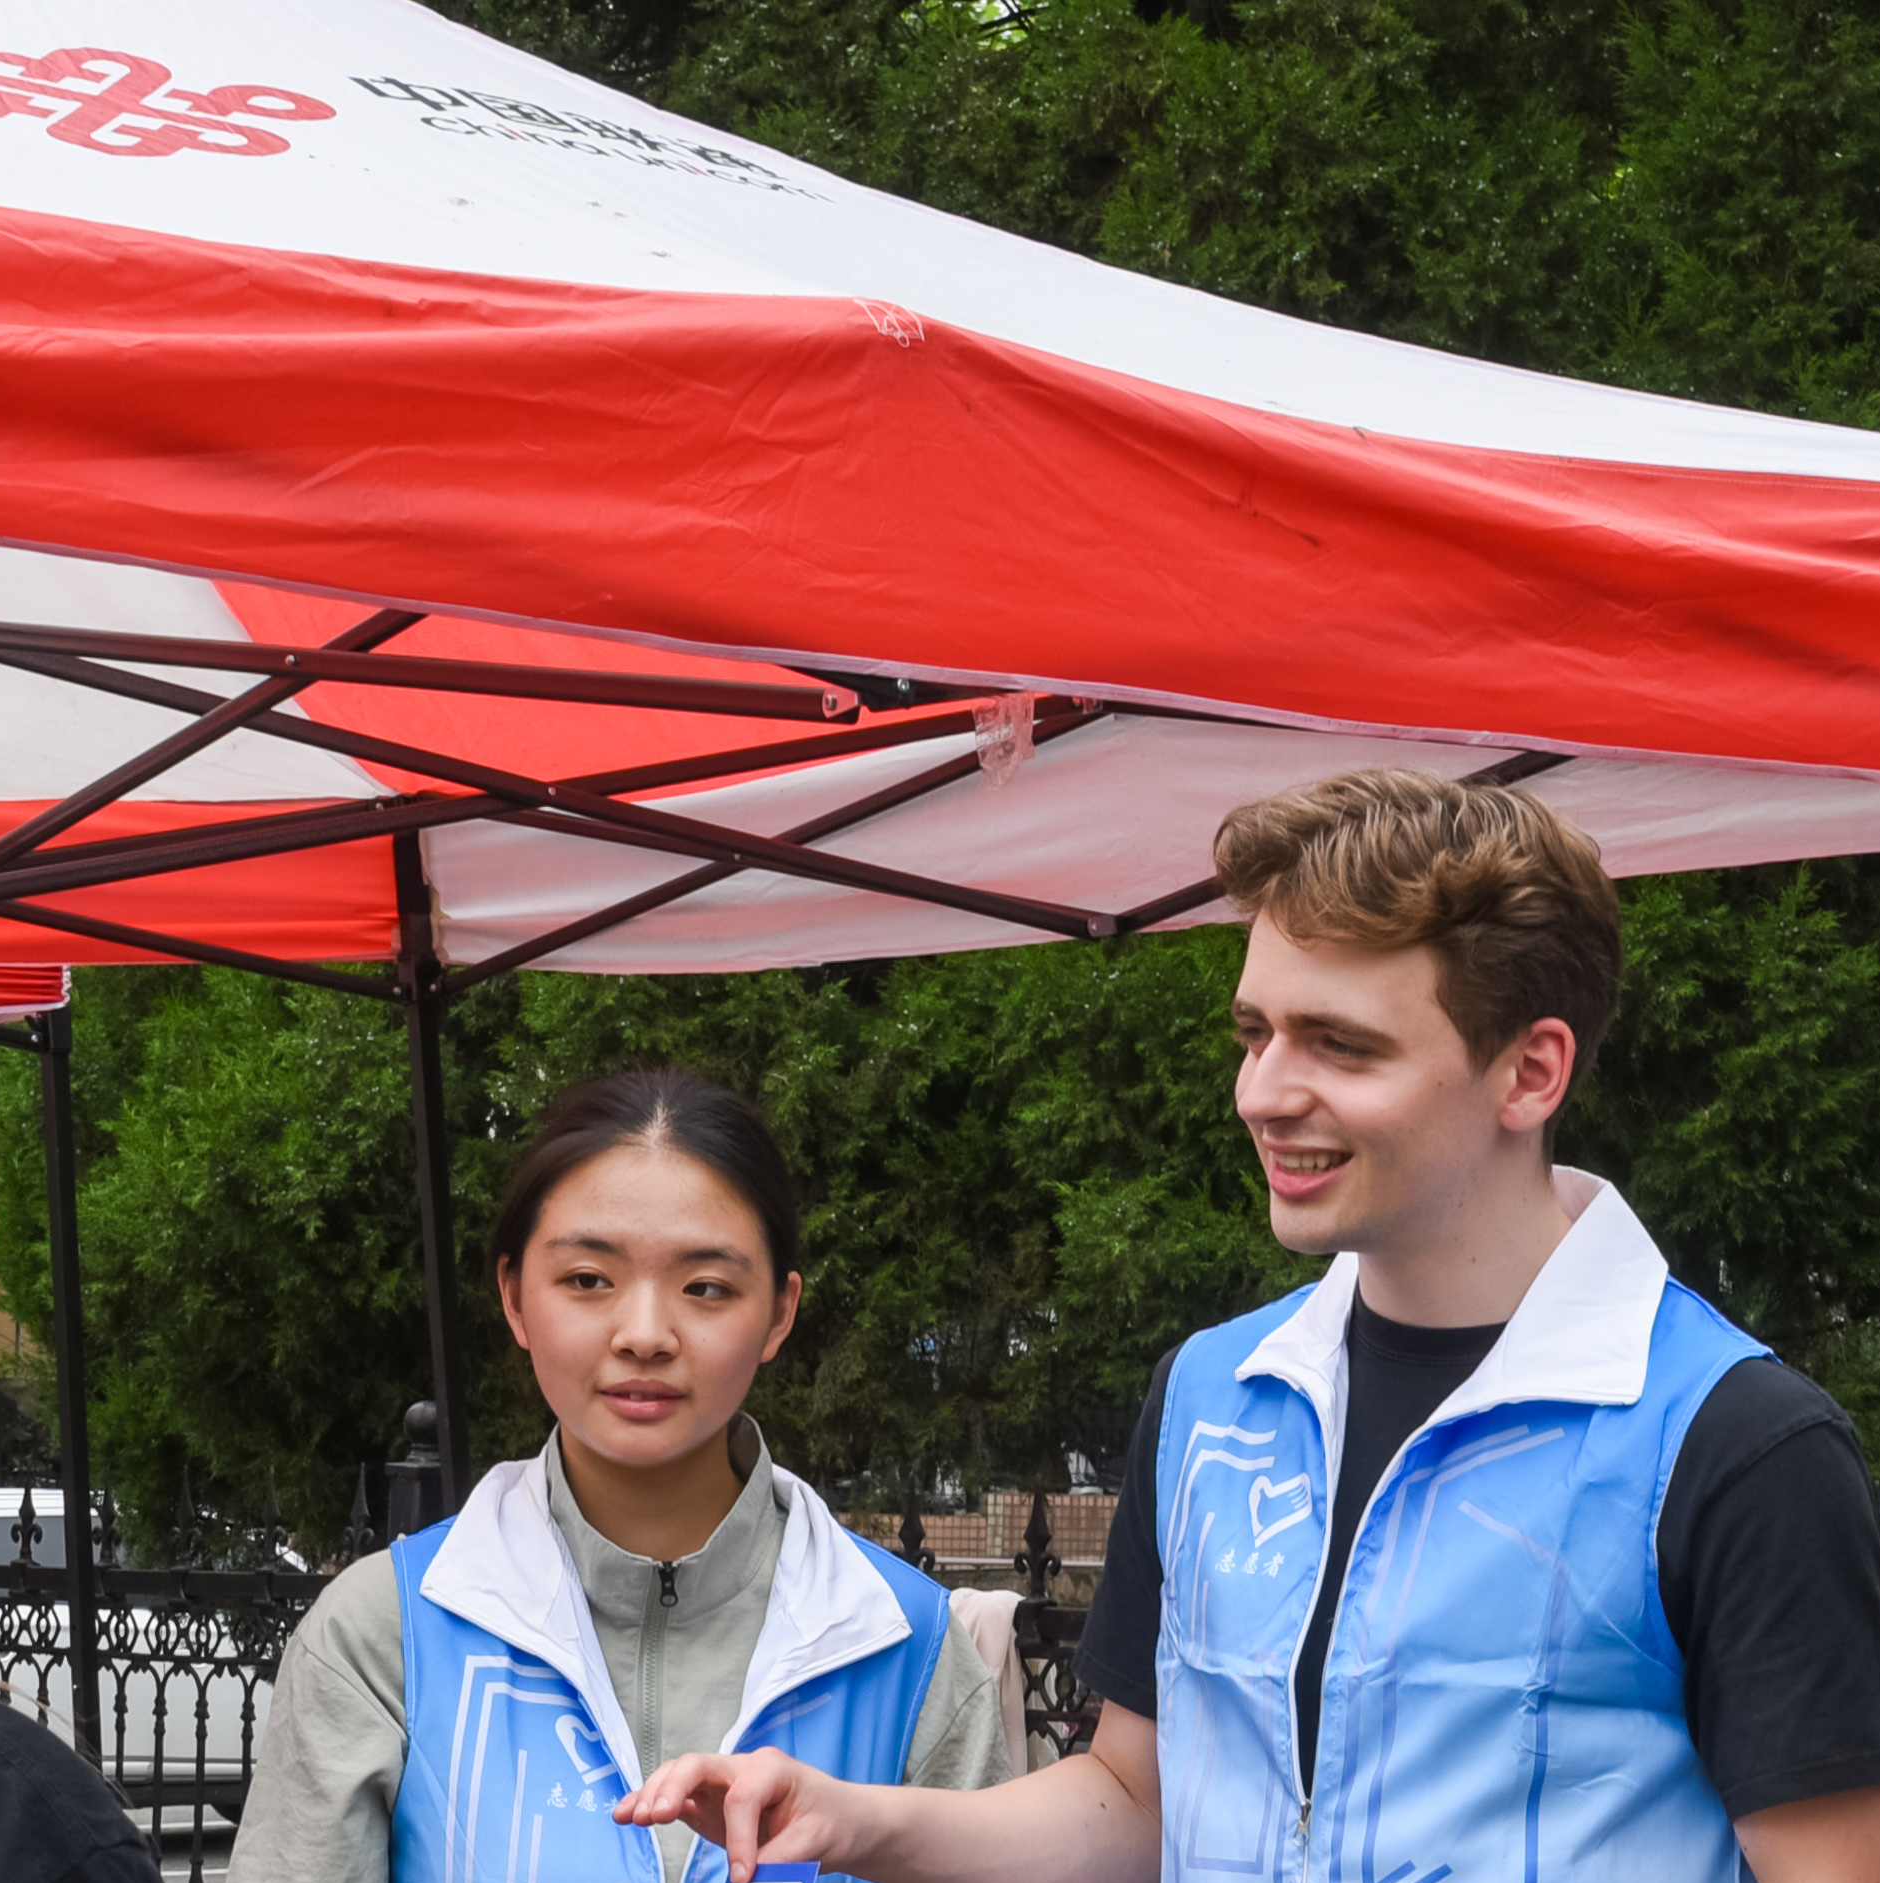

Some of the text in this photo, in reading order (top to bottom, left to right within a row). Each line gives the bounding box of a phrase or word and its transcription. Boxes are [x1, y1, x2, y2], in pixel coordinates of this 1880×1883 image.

[348, 76, 790, 182] 中国联通
[1214, 1548, 1285, 1578] 志愿者
